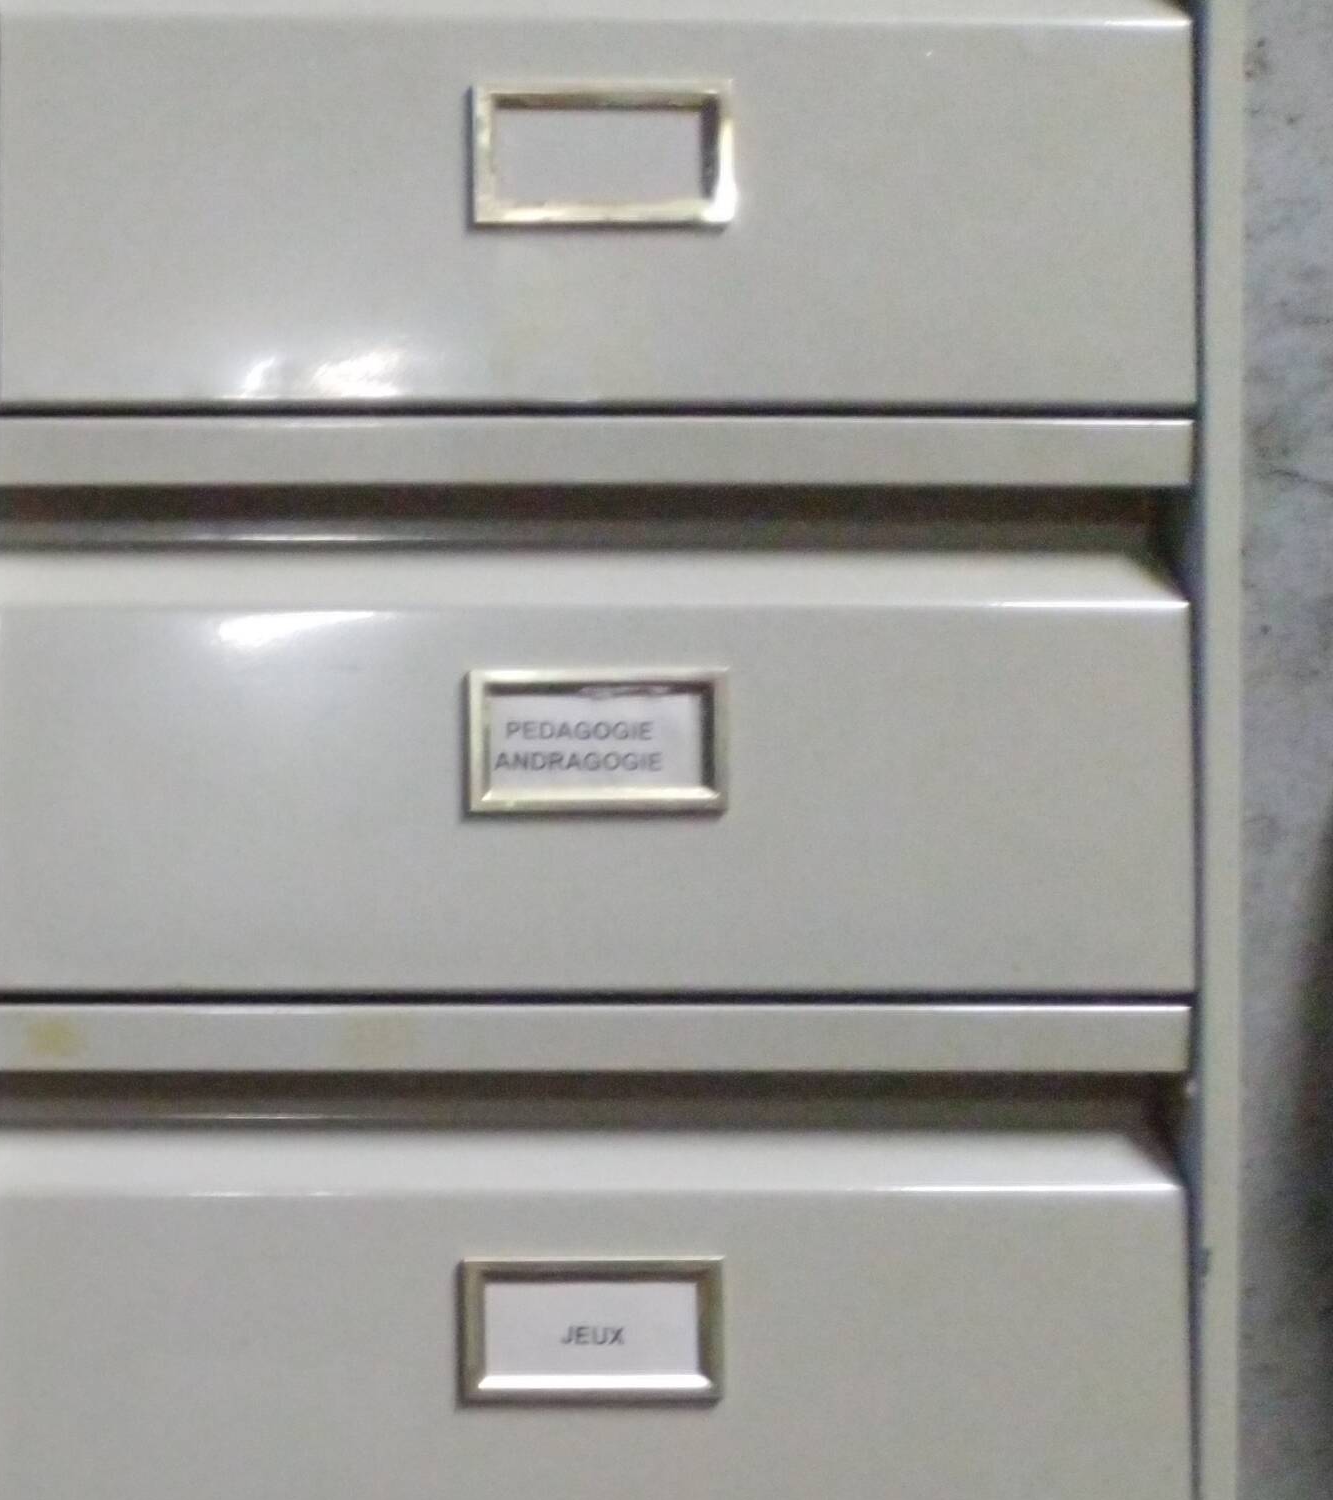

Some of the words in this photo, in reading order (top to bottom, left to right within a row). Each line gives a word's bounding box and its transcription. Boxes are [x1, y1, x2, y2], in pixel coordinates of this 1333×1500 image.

[505, 721, 654, 740] PEDAGOGIE
[494, 752, 662, 771] ANDRAGOGIE
[561, 1326, 625, 1345] JEUX
